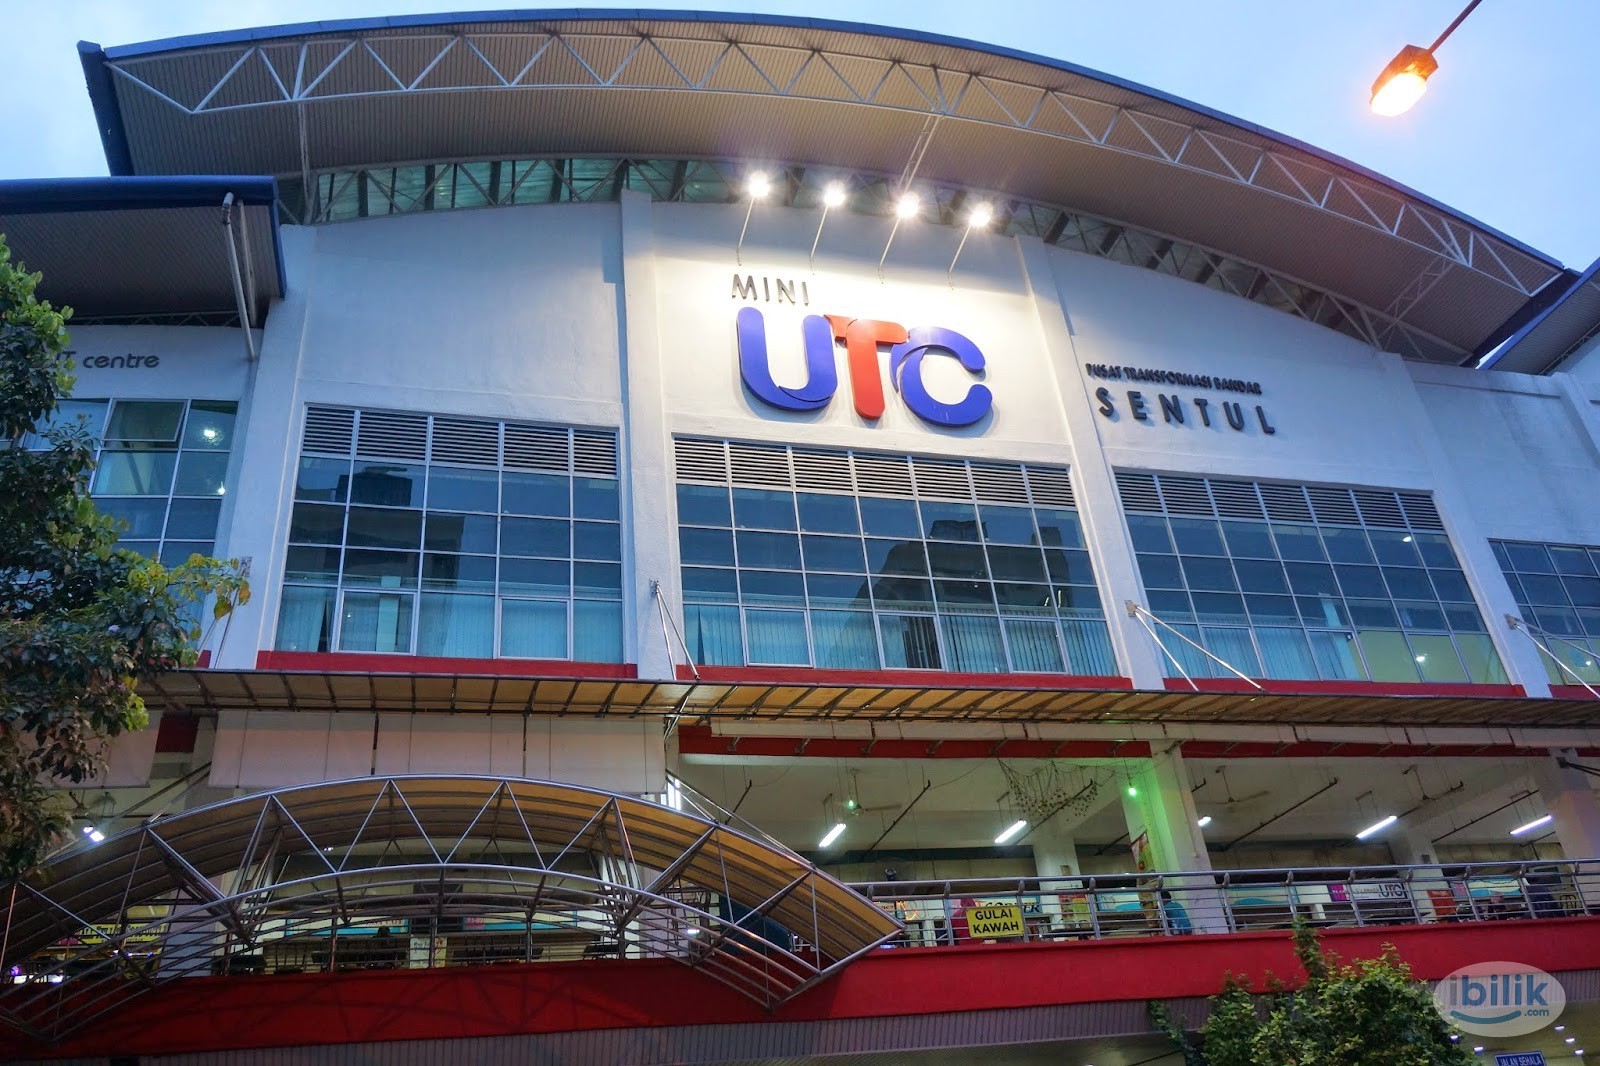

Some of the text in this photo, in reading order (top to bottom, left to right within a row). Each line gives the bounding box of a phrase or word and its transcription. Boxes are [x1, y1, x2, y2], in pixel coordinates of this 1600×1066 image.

[731, 273, 810, 306] MINI
[82, 353, 160, 369] centre
[736, 306, 993, 428] UTC
[1085, 363, 1262, 395] PUSAT TRANSFORMASI BANDAR
[1095, 386, 1276, 435] SENTUL
[973, 921, 1019, 933] KAWAH
[975, 908, 1013, 920] GULAI
